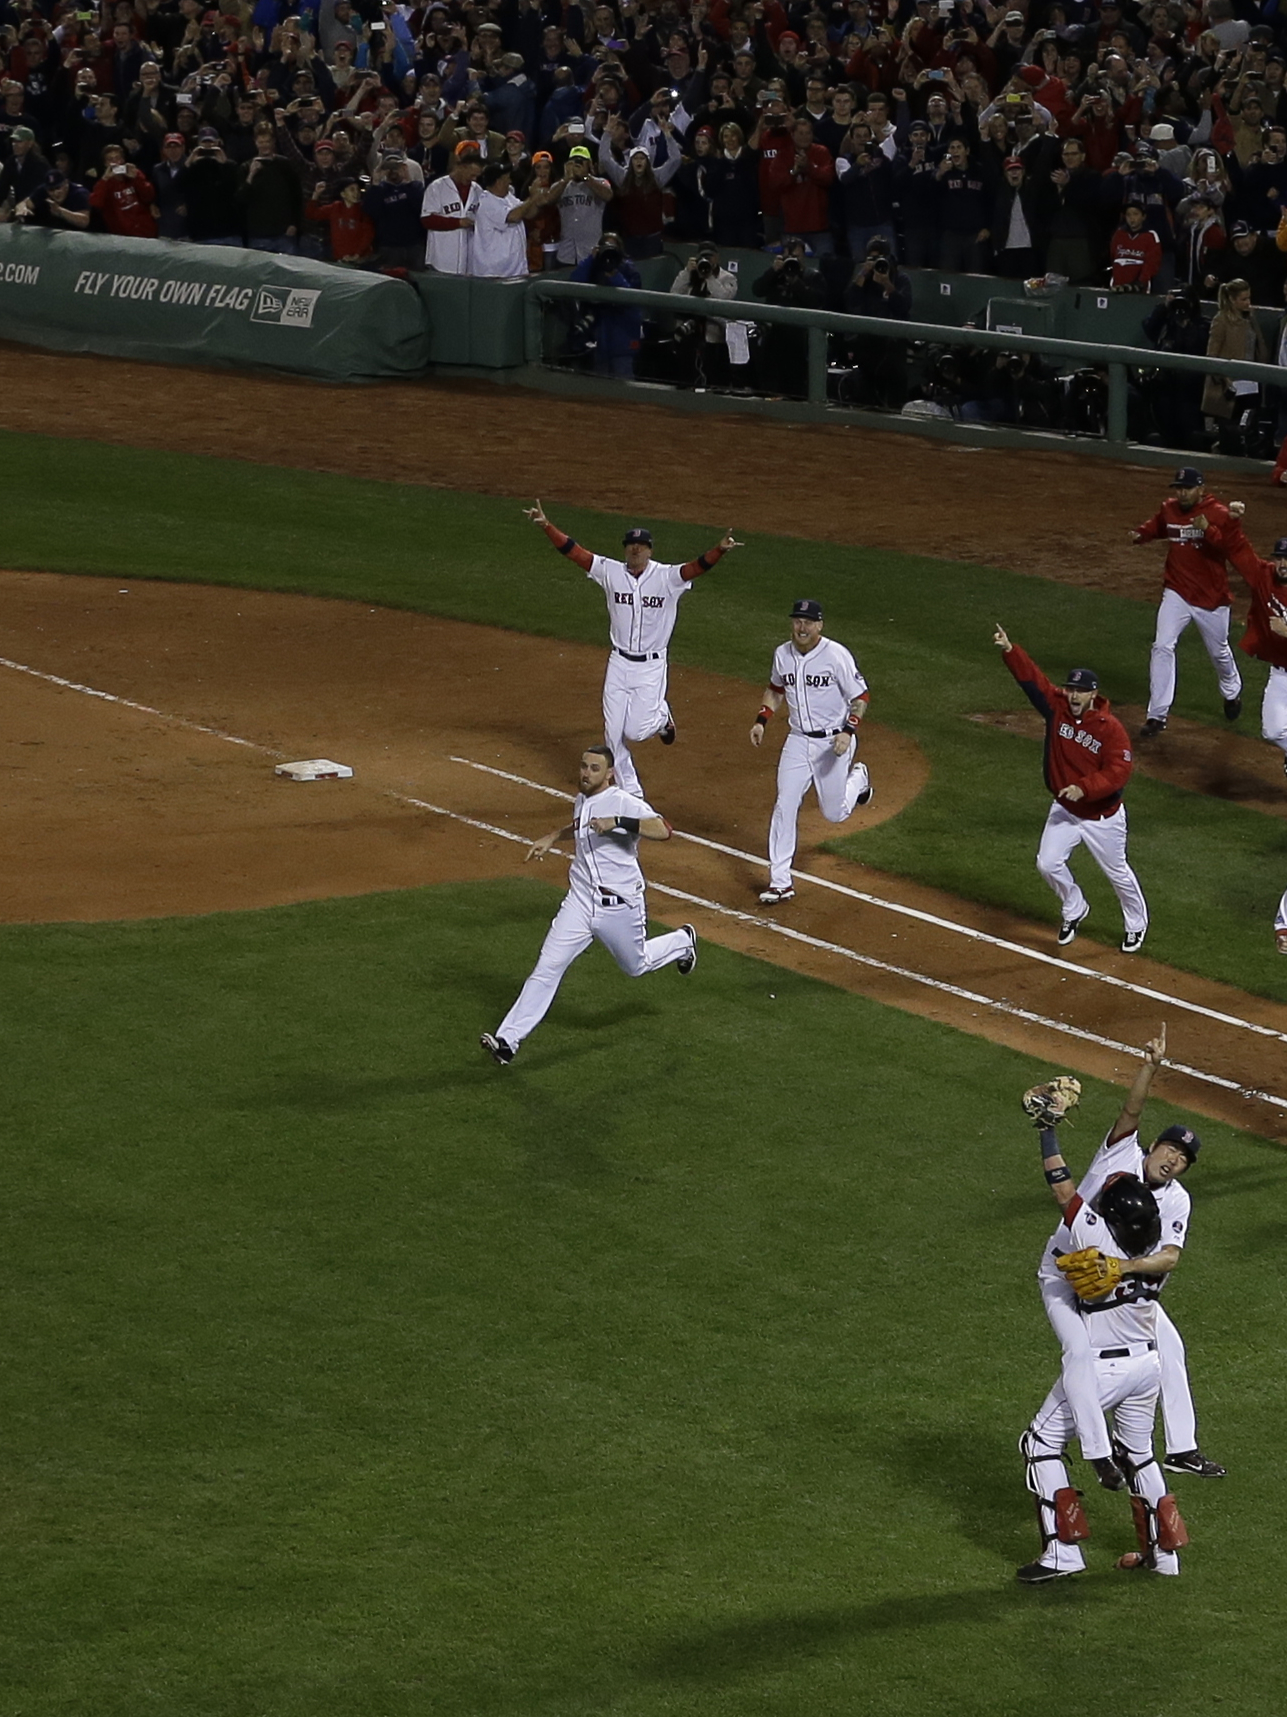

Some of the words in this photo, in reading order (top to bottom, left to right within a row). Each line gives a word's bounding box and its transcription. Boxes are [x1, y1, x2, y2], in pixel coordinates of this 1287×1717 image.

[443, 202, 461, 215] RED
[74, 270, 111, 296] FLY
[110, 273, 160, 301] YOUR
[159, 279, 208, 307] OWN
[205, 283, 253, 312] FLAG
[286, 306, 310, 318] ERA
[613, 591, 634, 605] RED
[642, 595, 666, 608] SOX
[805, 674, 830, 688] SOX
[1058, 721, 1076, 740] ED
[1074, 729, 1103, 755] SOX
